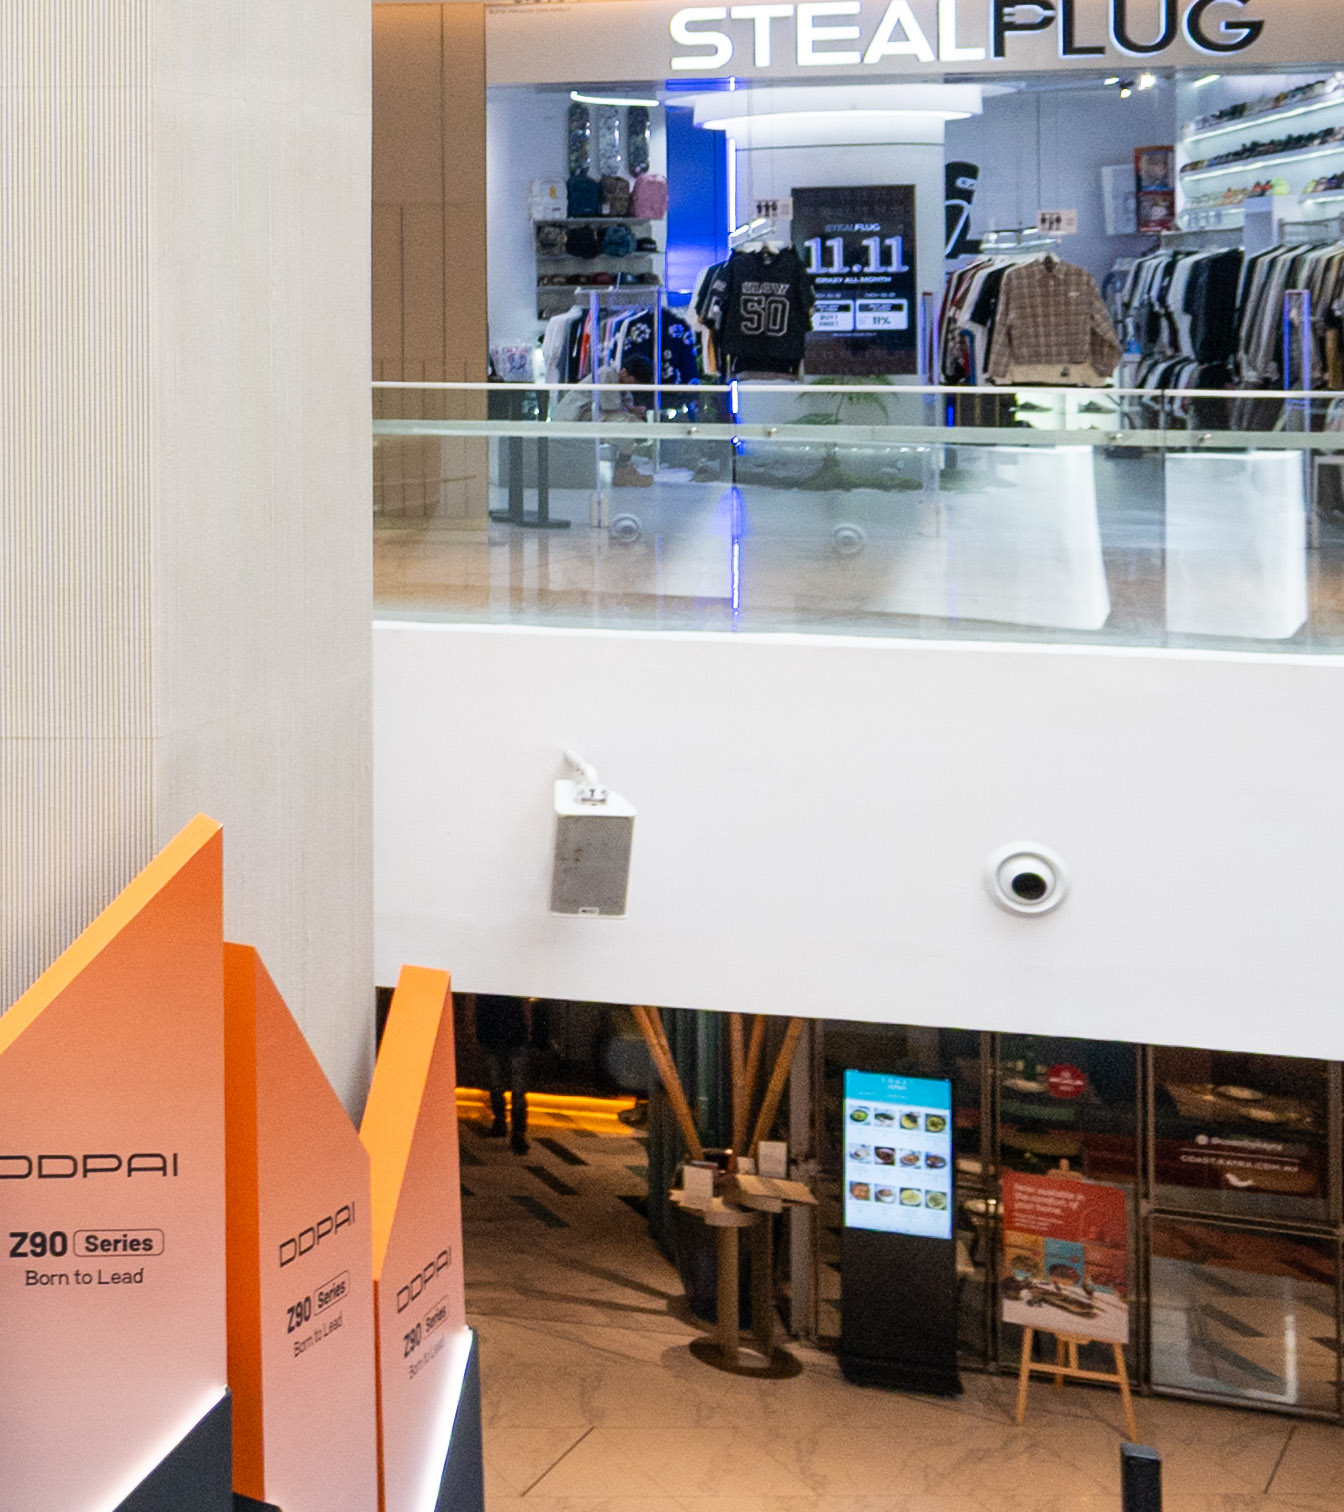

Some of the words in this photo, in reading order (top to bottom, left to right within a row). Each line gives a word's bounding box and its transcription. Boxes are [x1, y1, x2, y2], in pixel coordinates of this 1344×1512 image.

[804, 235, 910, 275] 11.11
[740, 295, 790, 336] 50
[9, 1231, 68, 1258] Z90
[84, 1233, 154, 1253] Series
[279, 1201, 356, 1268] DDPAI
[25, 1269, 70, 1286] Born
[75, 1269, 93, 1285] to
[97, 1267, 145, 1285] Lead
[397, 1245, 452, 1314] DDPAI
[287, 1295, 312, 1334] Z90
[317, 1280, 346, 1309] Series
[403, 1322, 422, 1358] Z90
